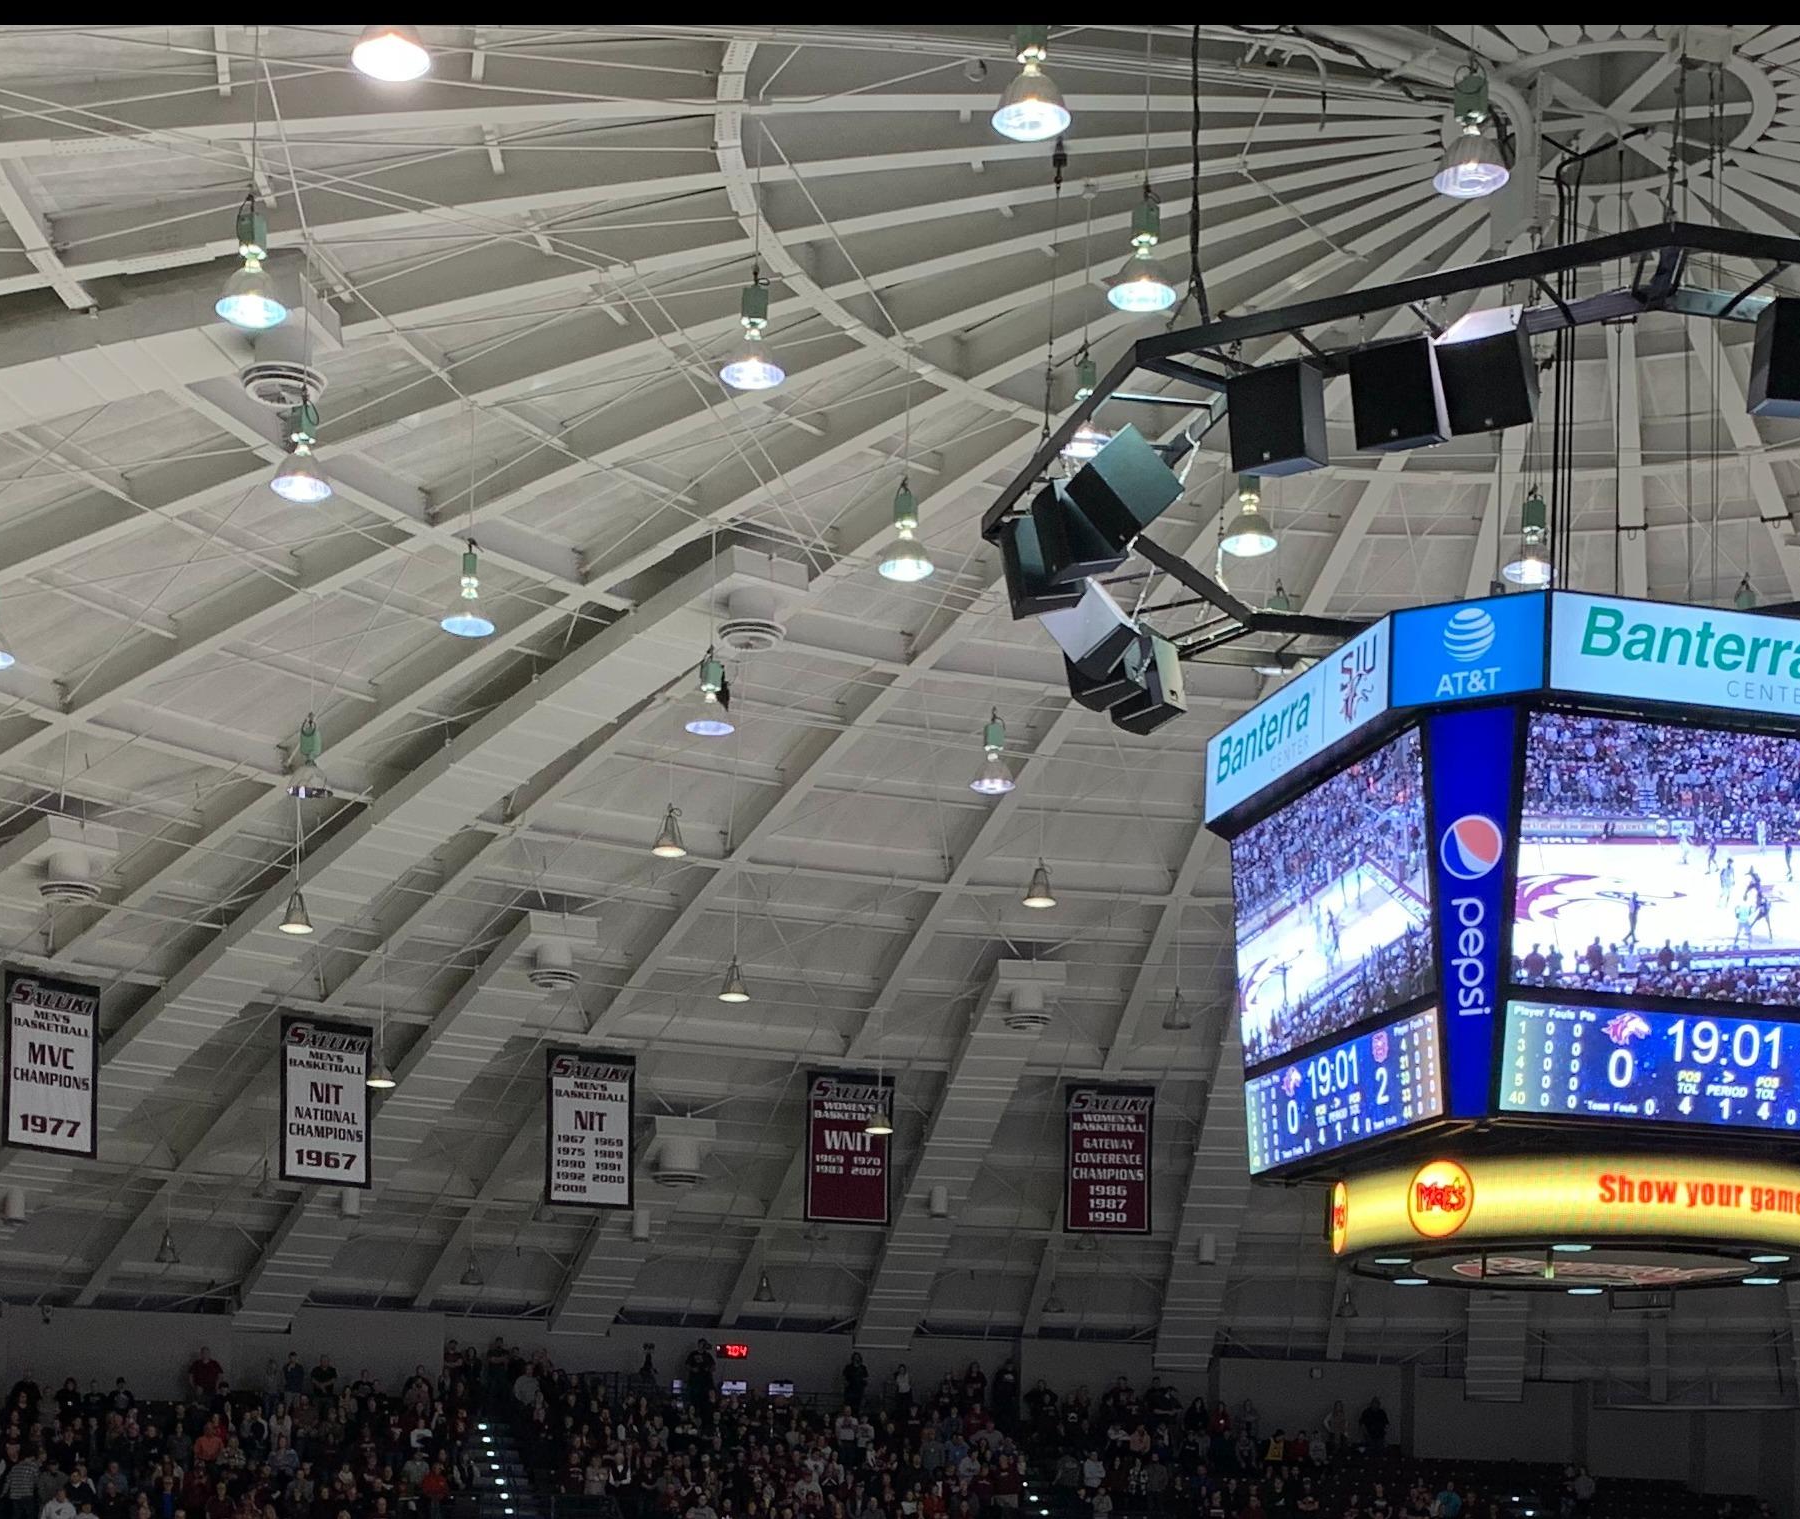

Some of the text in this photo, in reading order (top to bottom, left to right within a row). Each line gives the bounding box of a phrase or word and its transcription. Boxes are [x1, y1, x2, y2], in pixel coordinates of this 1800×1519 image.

[1340, 636, 1377, 676] SIU
[1436, 667, 1500, 697] AT&T
[1216, 692, 1311, 785] Banterra
[1450, 897, 1492, 1017] pepsi
[1514, 1006, 1544, 1018] Player
[1549, 1008, 1575, 1020] Fouls
[14, 1016, 90, 1038] BASKETBALL
[28, 1041, 74, 1070] MVC
[1667, 1019, 1782, 1070] 19:01
[289, 1058, 363, 1075] BASKETBALL
[1307, 1044, 1358, 1100] 19:01
[1608, 1049, 1633, 1088] 0
[13, 1067, 89, 1091] CHAMPIONS
[1375, 1067, 1389, 1105] 2
[1678, 1071, 1780, 1089] POS POS
[310, 1081, 343, 1105] NIT
[555, 1089, 627, 1103] BASKETBALL
[1508, 1091, 1526, 1105] 40
[1677, 1083, 1776, 1101] TOL PERIOD TOL
[295, 1106, 358, 1125] NATIONAL
[1287, 1099, 1299, 1134] 0
[1678, 1097, 1770, 1120] 4 4
[20, 1113, 80, 1138] 1977
[574, 1110, 607, 1132] NIT
[1073, 1122, 1145, 1133] BASKETBALL
[289, 1122, 363, 1143] CHAMPIONS
[824, 1130, 874, 1152] WNIT
[1083, 1138, 1134, 1150] GATEWAY
[295, 1148, 357, 1170] 1967
[1075, 1152, 1142, 1165] CONFERENCE
[1073, 1168, 1144, 1181] CHAMPIONS
[1089, 1185, 1127, 1196] 1986
[1599, 1174, 1677, 1206] Show
[1686, 1180, 1743, 1209] your
[1089, 1199, 1127, 1210] 1987
[1088, 1212, 1127, 1223] 1990
